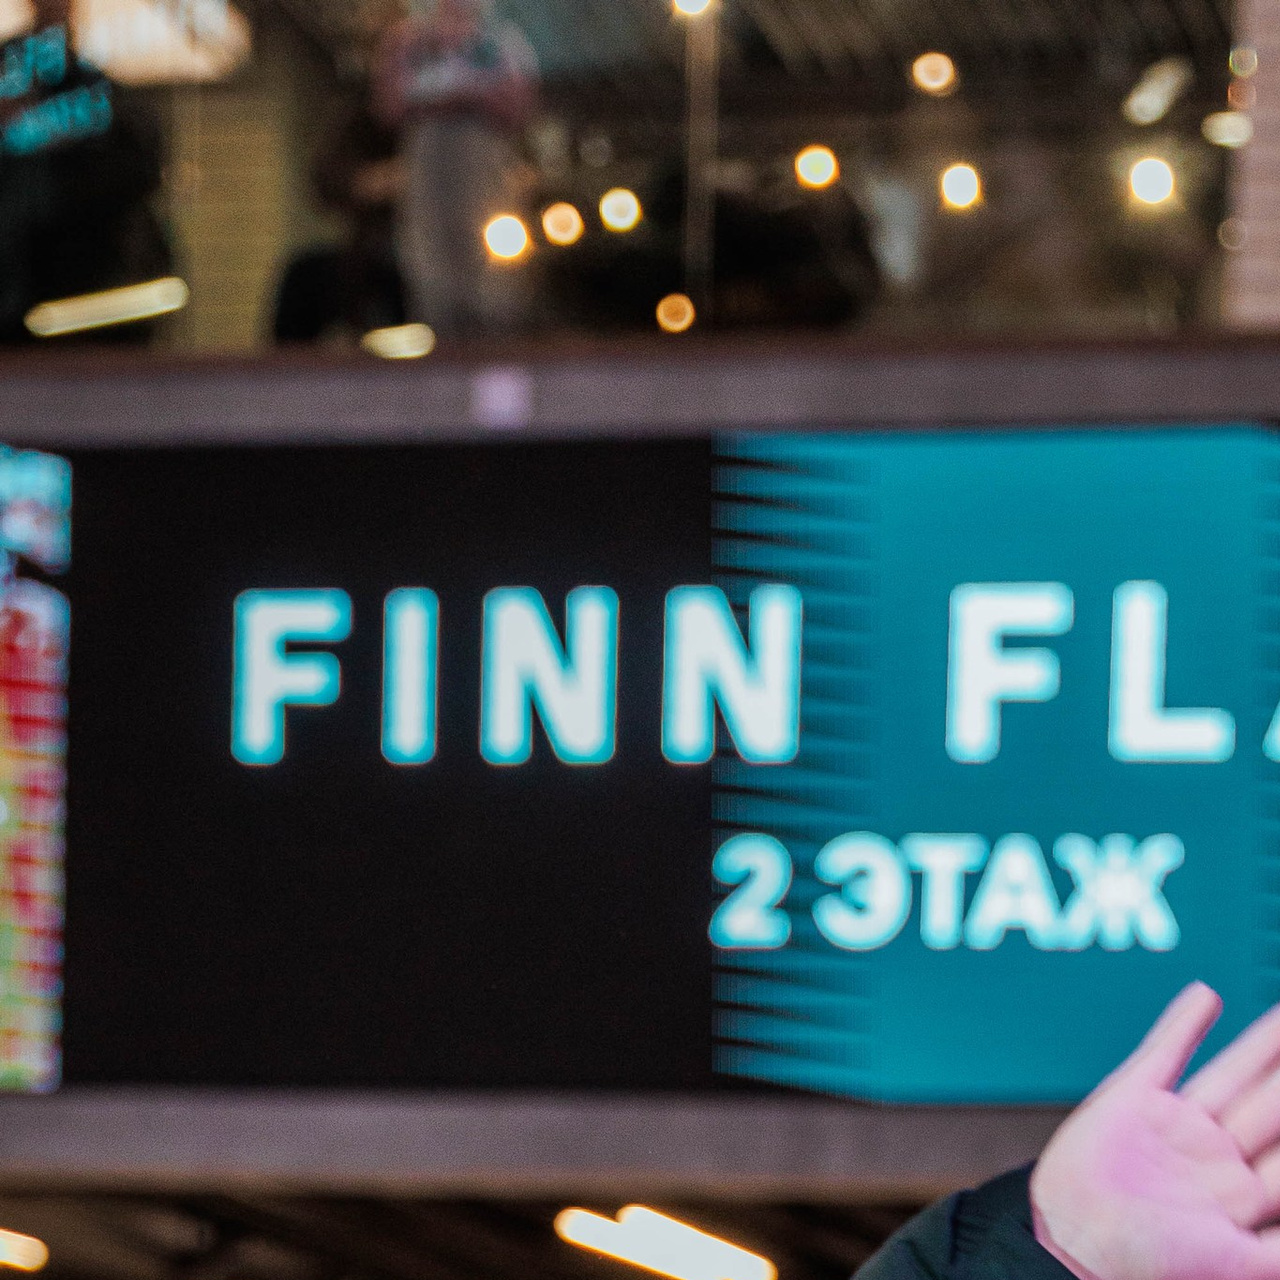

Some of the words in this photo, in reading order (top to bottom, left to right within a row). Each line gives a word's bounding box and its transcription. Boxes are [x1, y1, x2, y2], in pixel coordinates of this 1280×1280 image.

[232, 584, 803, 766] FINN
[709, 832, 793, 948] 2
[812, 831, 1185, 951] ЭТАЖ
